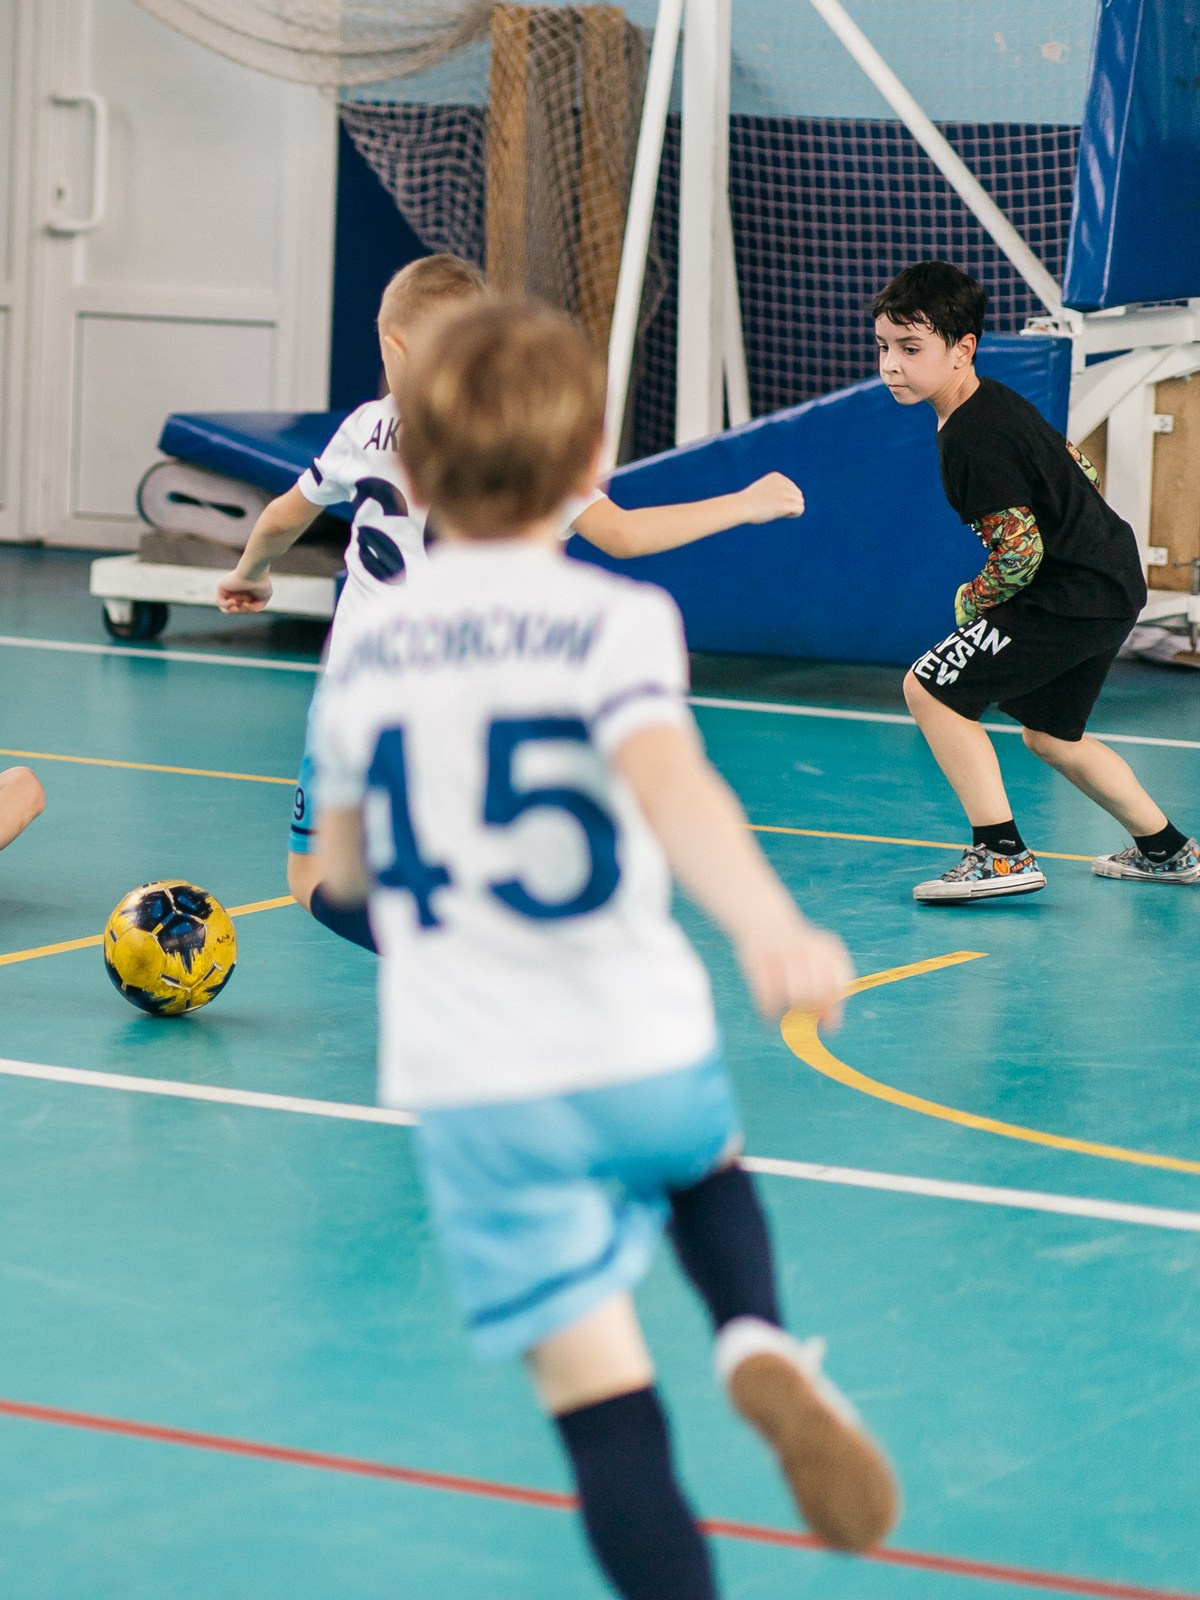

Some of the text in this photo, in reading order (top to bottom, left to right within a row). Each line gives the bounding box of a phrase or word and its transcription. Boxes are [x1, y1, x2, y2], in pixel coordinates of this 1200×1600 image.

[933, 632, 976, 669] YS
[959, 615, 1013, 656] AN
[911, 650, 960, 687] EW
[293, 787, 305, 821] 9
[368, 715, 621, 927] 45
